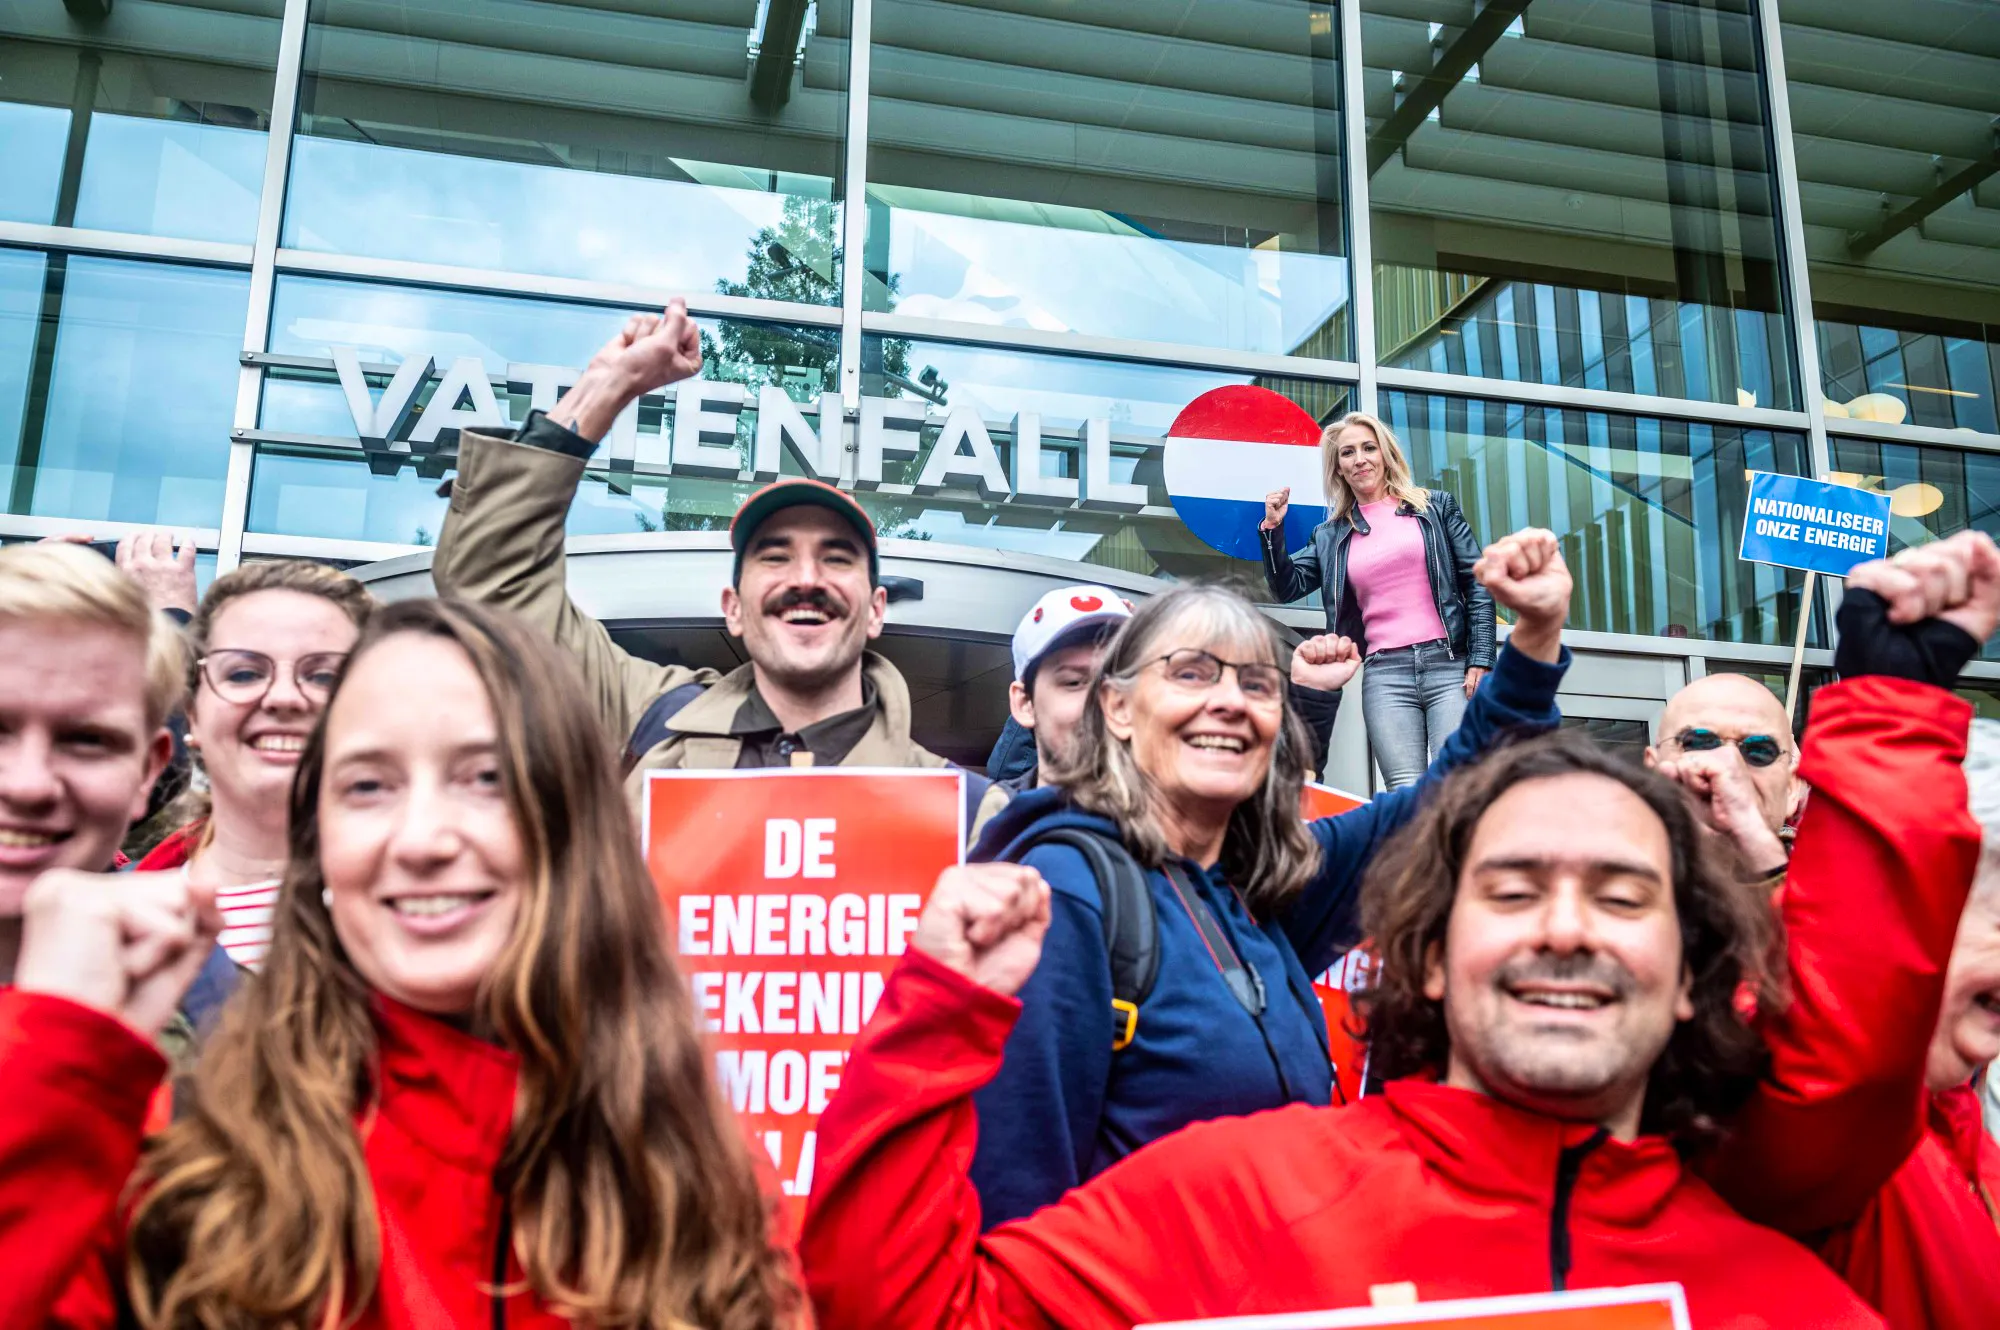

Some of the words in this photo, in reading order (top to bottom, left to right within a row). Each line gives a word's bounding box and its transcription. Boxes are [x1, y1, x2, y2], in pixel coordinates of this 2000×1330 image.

[1754, 498, 1883, 535] NATIONALISEER
[1756, 519, 1800, 541] ONZE
[1804, 527, 1876, 555] ENERGIE
[764, 818, 837, 879] DE
[715, 1049, 851, 1115] MOE
